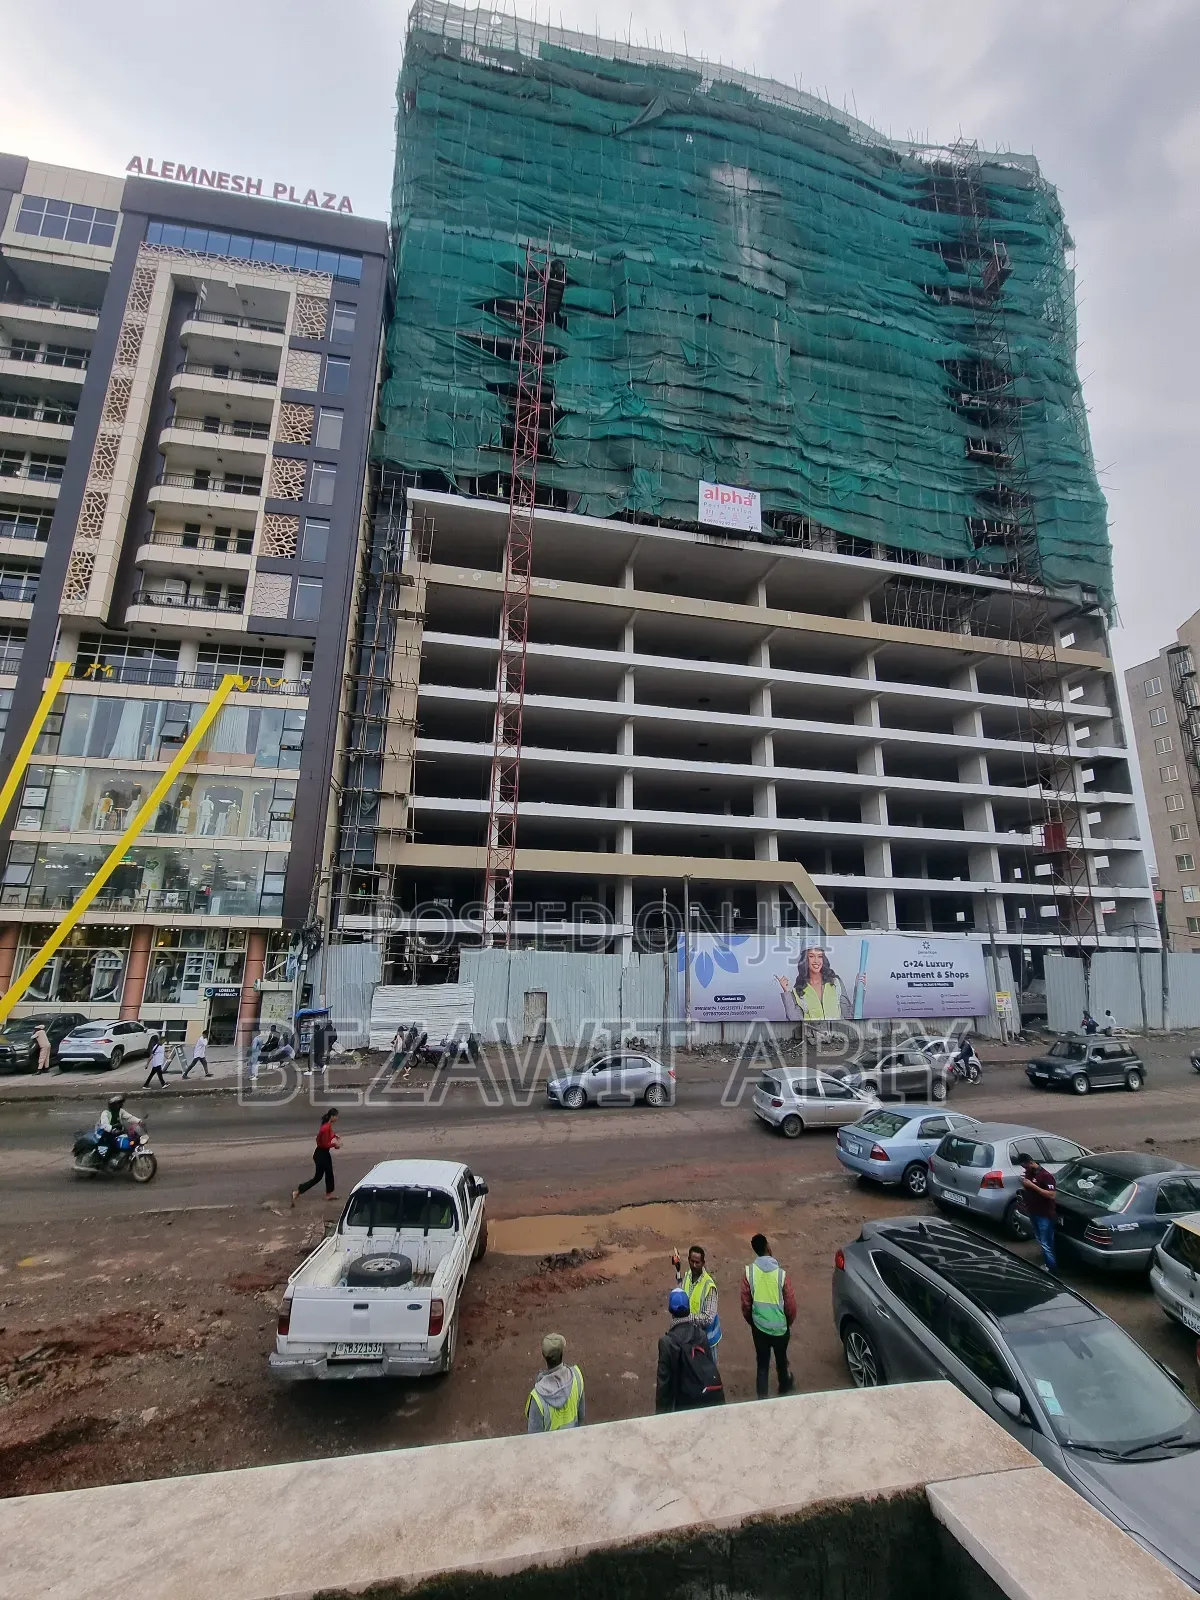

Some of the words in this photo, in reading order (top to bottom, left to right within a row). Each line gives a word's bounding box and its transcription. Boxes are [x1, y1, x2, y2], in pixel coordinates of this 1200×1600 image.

[126, 155, 263, 196] ALEMNESH
[272, 182, 354, 214] PLAZA
[704, 487, 753, 506] alpha
[903, 960, 924, 968] G+24
[925, 960, 954, 969] Luxury
[890, 971, 935, 980] Apartment
[937, 971, 943, 979] &
[944, 971, 970, 980] Shops
